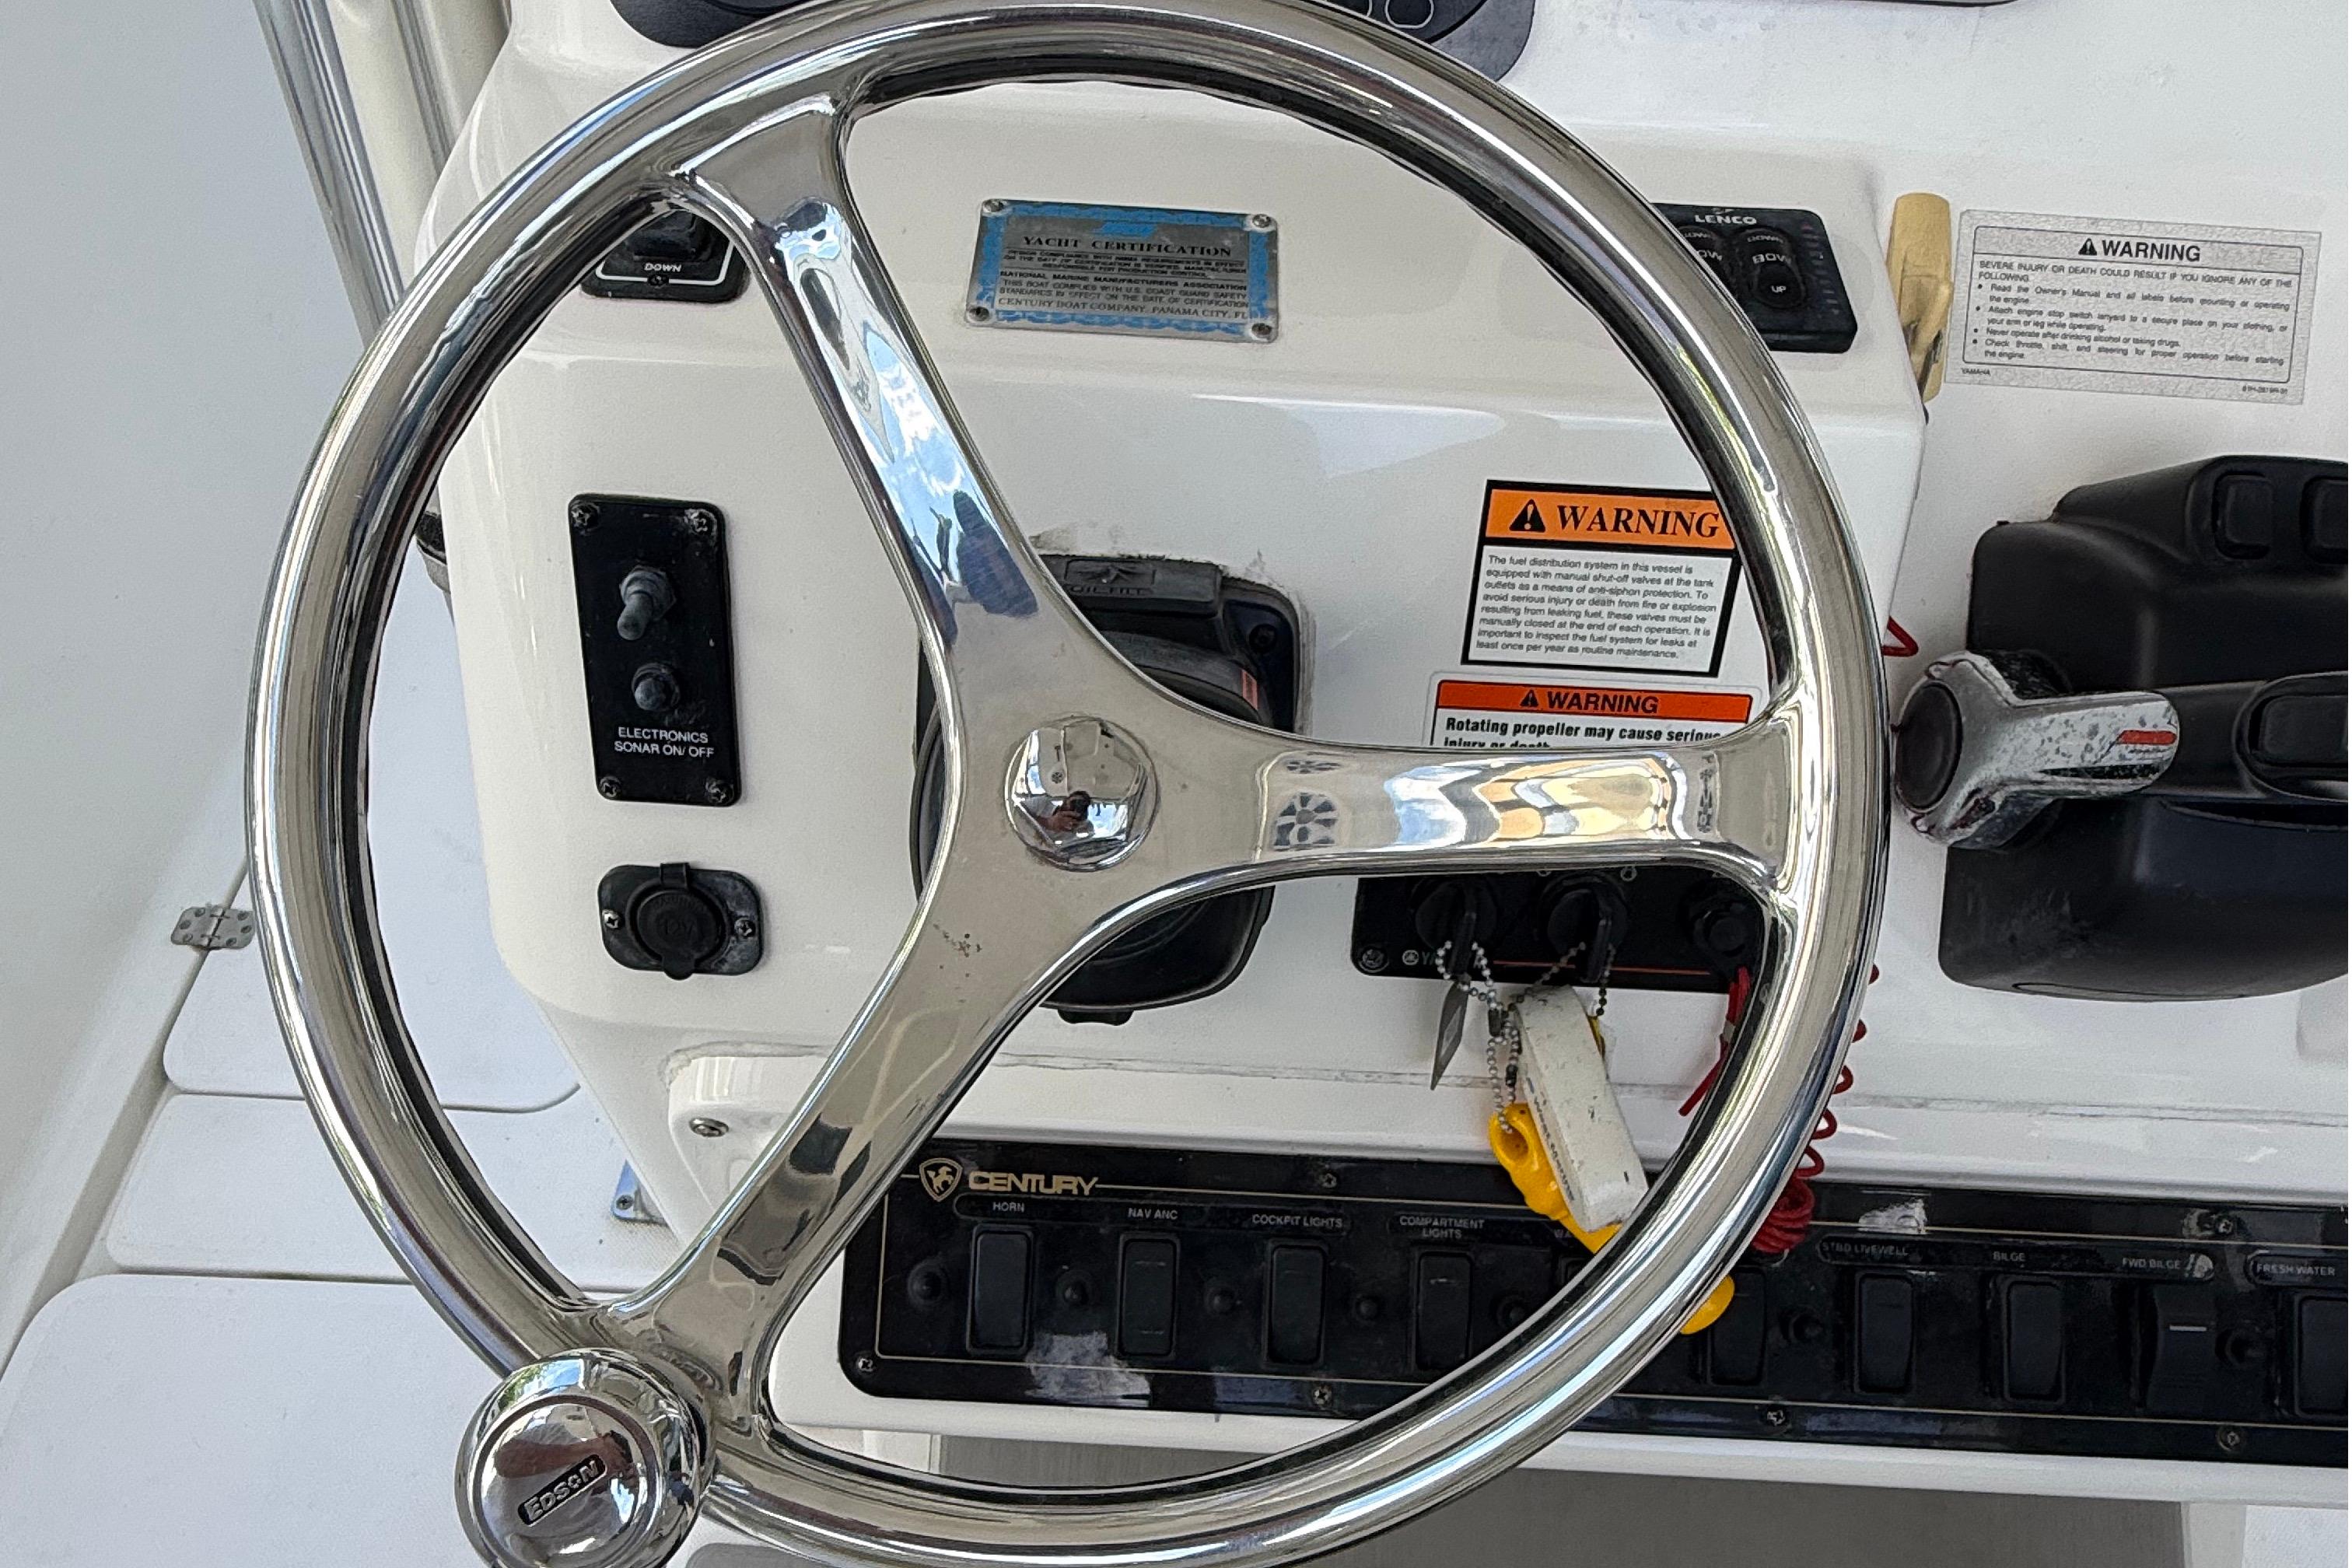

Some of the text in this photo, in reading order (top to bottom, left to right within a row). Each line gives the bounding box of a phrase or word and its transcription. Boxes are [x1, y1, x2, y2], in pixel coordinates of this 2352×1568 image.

[1695, 214, 1757, 226] LENCO
[1024, 236, 1231, 257] YACHT CERTIFICATION
[2102, 240, 2200, 262] WARNING
[1697, 249, 1791, 266] OW BOW
[644, 263, 682, 272] DOWN
[1183, 282, 1246, 290] ASSOCIATION
[1770, 285, 1787, 294] UP
[999, 287, 1052, 296] STANDARDS
[1183, 298, 1248, 307] CERTIFICATION
[998, 297, 1053, 307] CENTURY
[1056, 300, 1087, 309] BOAT
[1152, 306, 1198, 315] PANAMA
[1557, 505, 1720, 538] WARNING
[1488, 555, 1507, 564] The
[1509, 556, 1527, 565] fuel
[1529, 558, 1581, 568] distribution
[1584, 561, 1618, 571] system
[1632, 562, 1649, 571] this
[1651, 564, 1682, 573] vessel
[1486, 568, 1530, 579] equipped
[1554, 572, 1590, 581] manual
[1592, 572, 1629, 583] shut-off
[1631, 576, 1661, 584] valves
[1675, 577, 1692, 586] the
[1575, 584, 1585, 593] of
[1696, 590, 1709, 599] To
[1482, 593, 1508, 601] avoid
[1547, 597, 1573, 607] injury
[1617, 599, 1640, 607] from
[1641, 600, 1657, 609] fire
[1480, 605, 1521, 615] resulting
[1523, 607, 1545, 615] from
[1547, 607, 1581, 619] leaking
[1607, 611, 1633, 620] these
[1635, 613, 1665, 621] valves
[1668, 614, 1691, 623] must
[1479, 616, 1521, 628] manually
[1524, 618, 1555, 628] closed
[1586, 621, 1605, 630] end
[1477, 629, 1521, 639] important
[1535, 632, 1569, 642] inspect
[1589, 633, 1607, 642] fuel
[1608, 635, 1643, 646] system
[1660, 637, 1685, 646] leaks
[1525, 644, 1541, 653] per
[1544, 645, 1565, 653] year
[1547, 691, 1659, 715] WARNING
[618, 726, 709, 744] ELECTRONICS
[1446, 717, 1508, 736] Rotating
[1513, 722, 1580, 739] propeller
[1584, 726, 1614, 742] may
[1619, 728, 1663, 741] cause
[614, 740, 660, 754] SONAR
[688, 746, 715, 758] OFF
[968, 1171, 1098, 1195] CENTURY
[992, 1201, 1025, 1213] HORN
[1129, 1208, 1178, 1220] NAV ANC
[1251, 1213, 1343, 1229] COCKPIT LIGHTS
[1400, 1216, 1485, 1230] COMPARTMENT
[1423, 1229, 1462, 1239] LIGHTS
[1993, 1251, 2026, 1262] BILGE
[2122, 1257, 2180, 1270] FWD BILGE
[2256, 1263, 2336, 1276] FRESH WATER
[523, 1460, 601, 1519] EDSON
